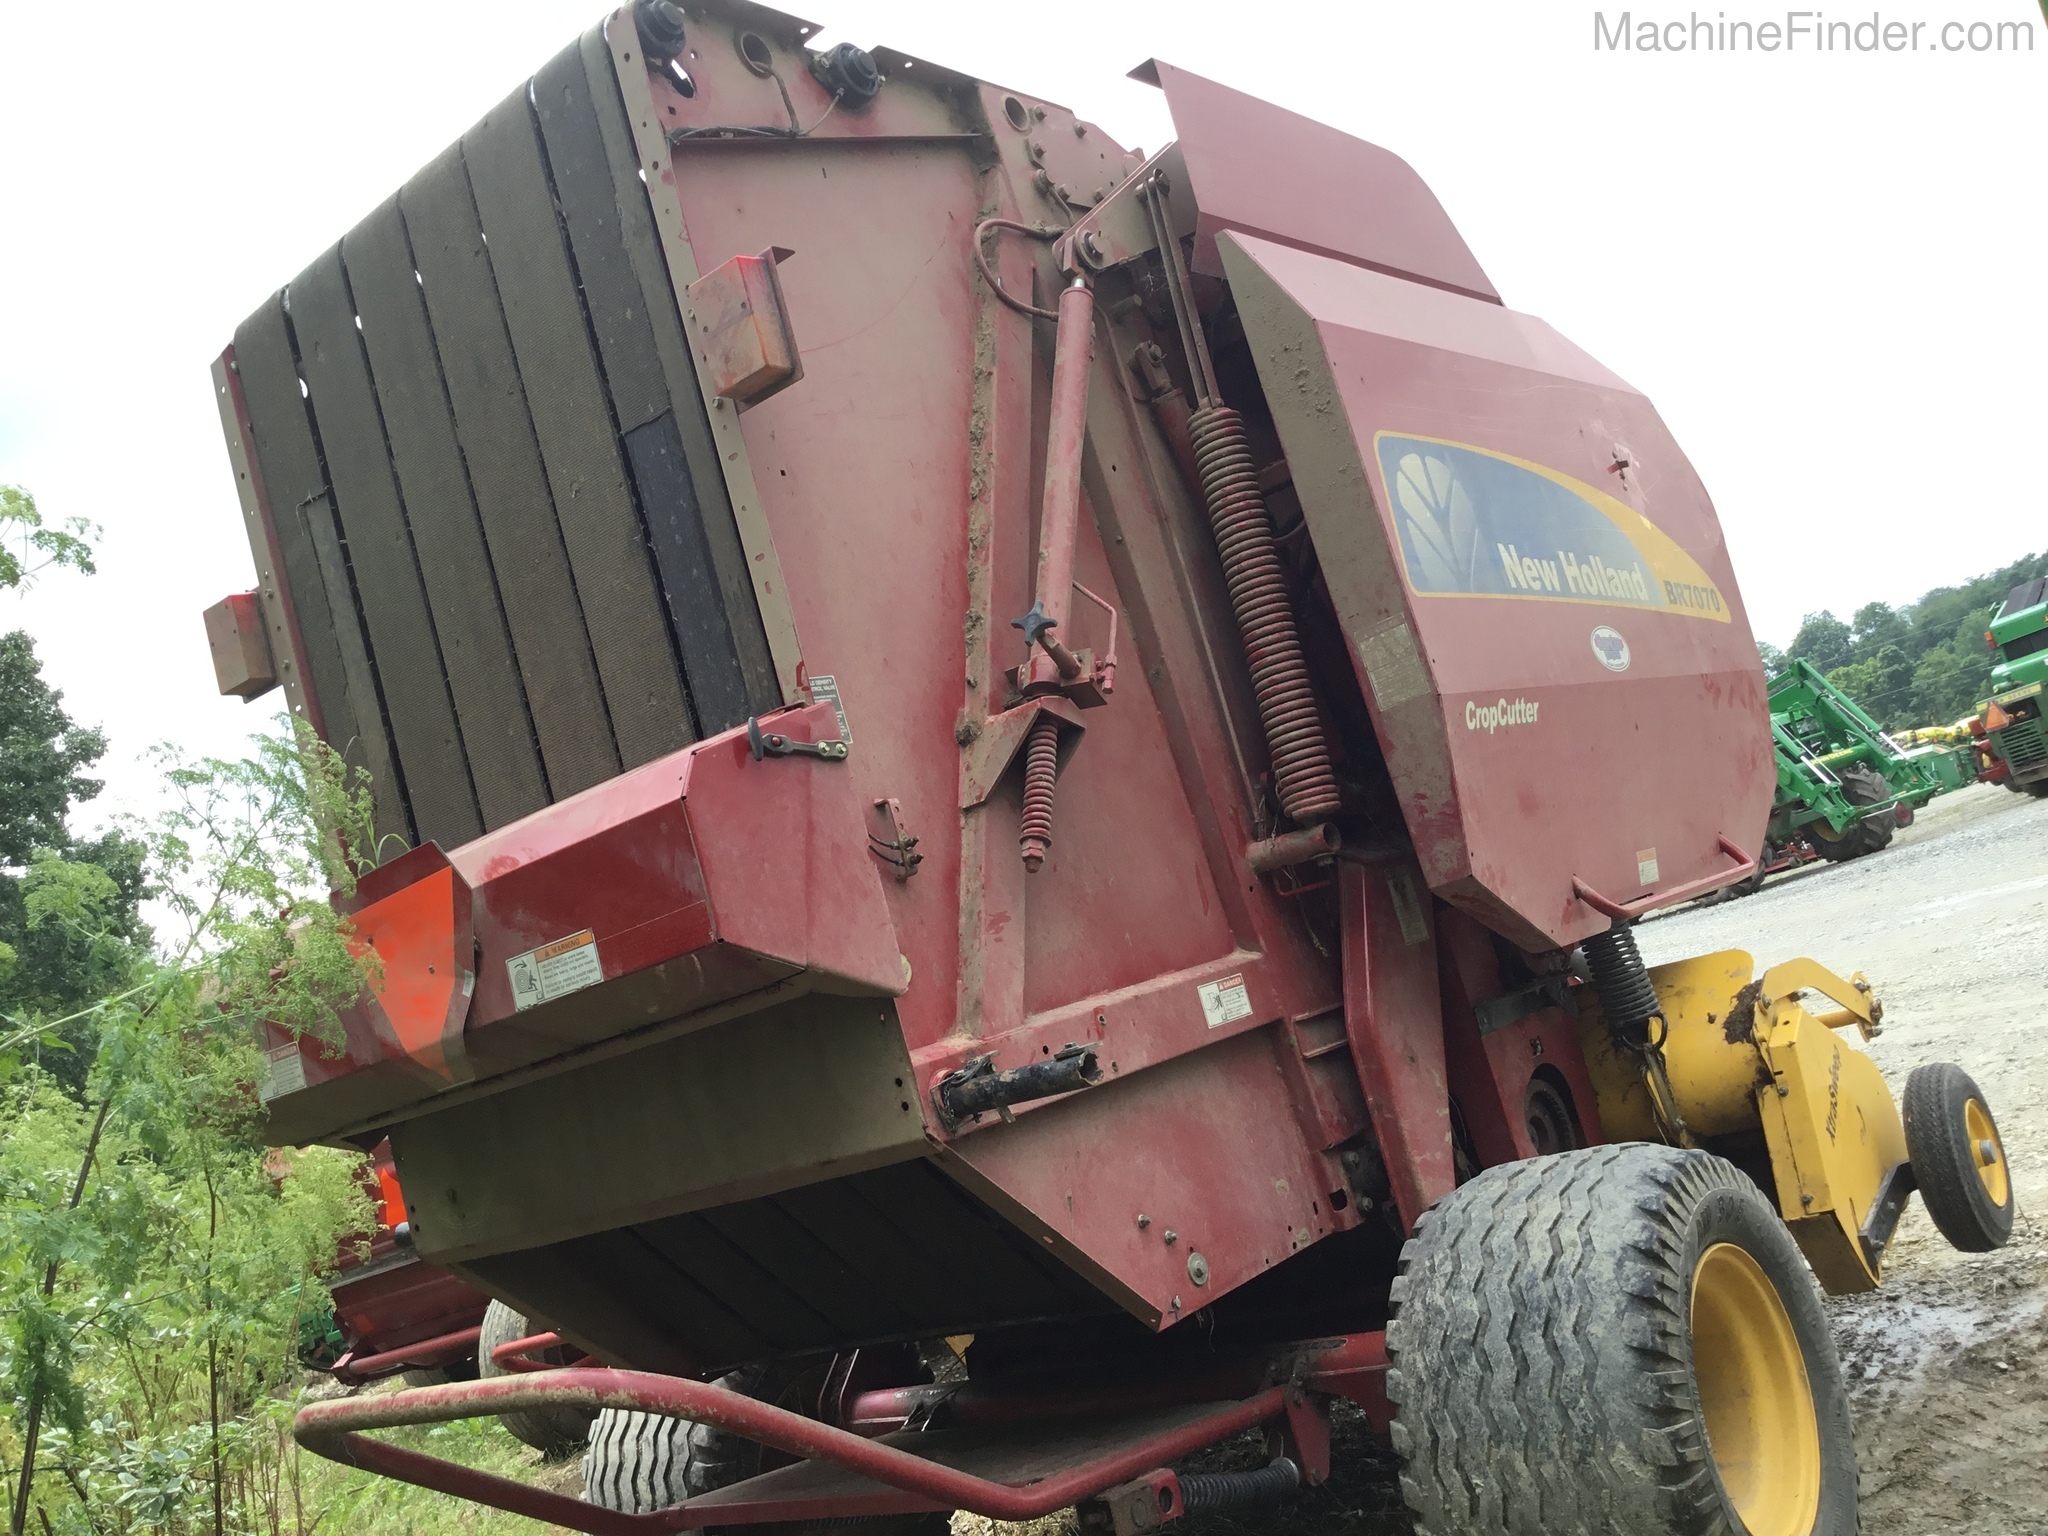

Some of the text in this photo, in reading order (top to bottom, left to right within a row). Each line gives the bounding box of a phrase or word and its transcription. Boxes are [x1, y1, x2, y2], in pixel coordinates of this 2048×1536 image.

[1497, 543, 1650, 601] New Holland
[1663, 580, 1721, 613] BR7070
[1465, 697, 1539, 734] CropCutter
[551, 938, 580, 954] WARNING
